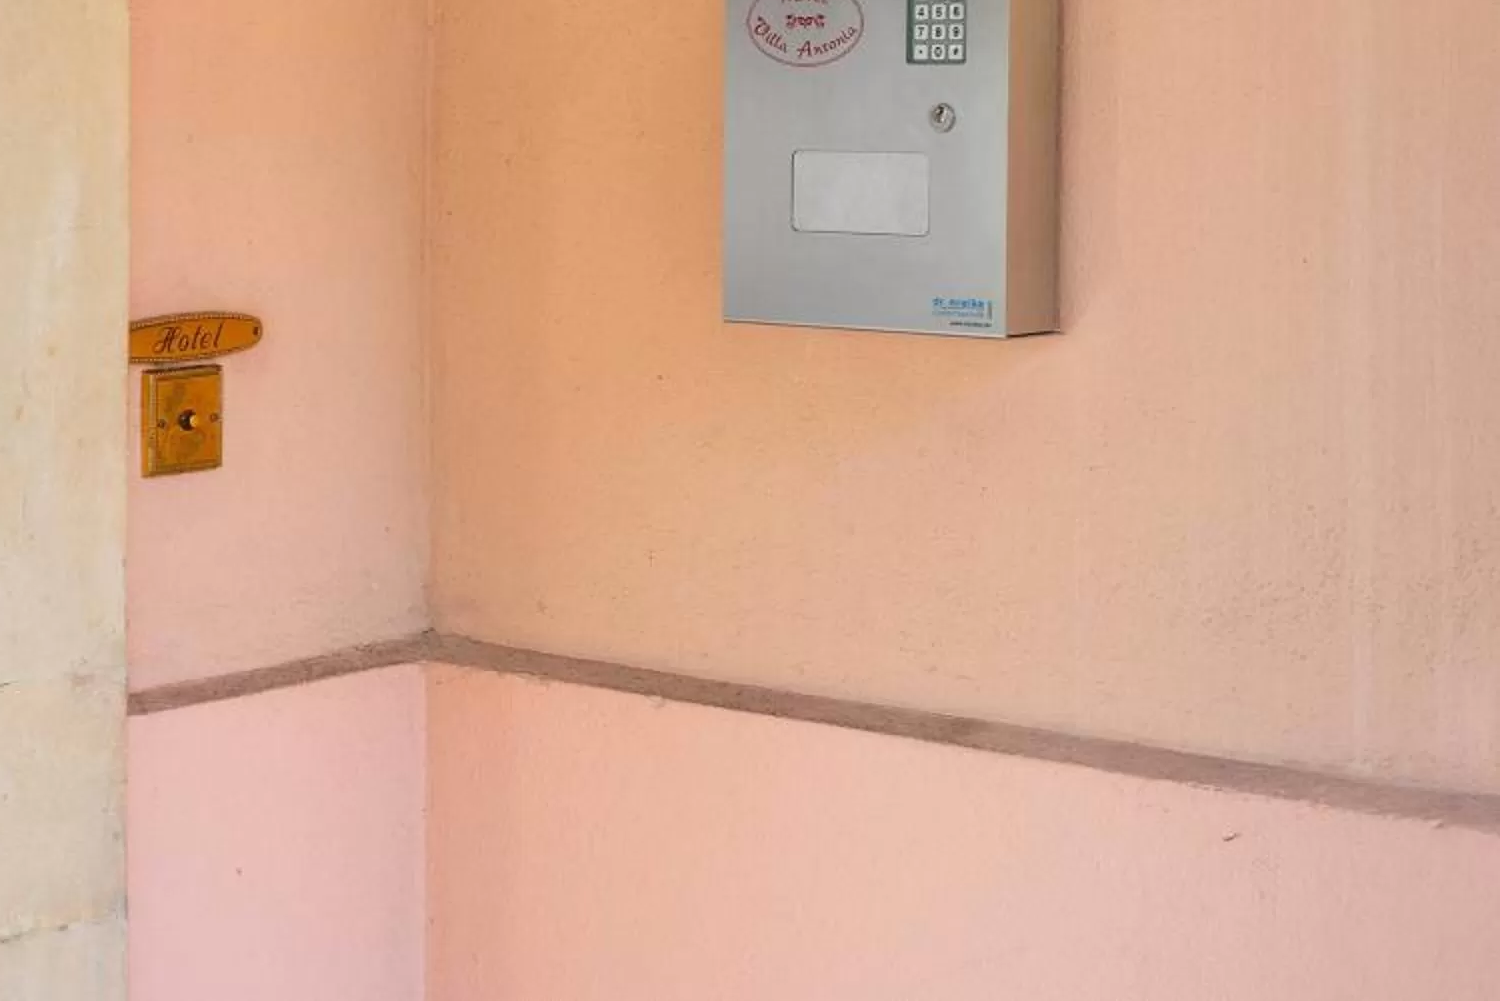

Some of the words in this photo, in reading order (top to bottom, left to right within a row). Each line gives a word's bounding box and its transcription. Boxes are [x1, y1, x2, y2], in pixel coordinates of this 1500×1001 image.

[754, 15, 788, 54] Villa
[797, 26, 858, 58] Antonia
[153, 320, 225, 354] Hotel
